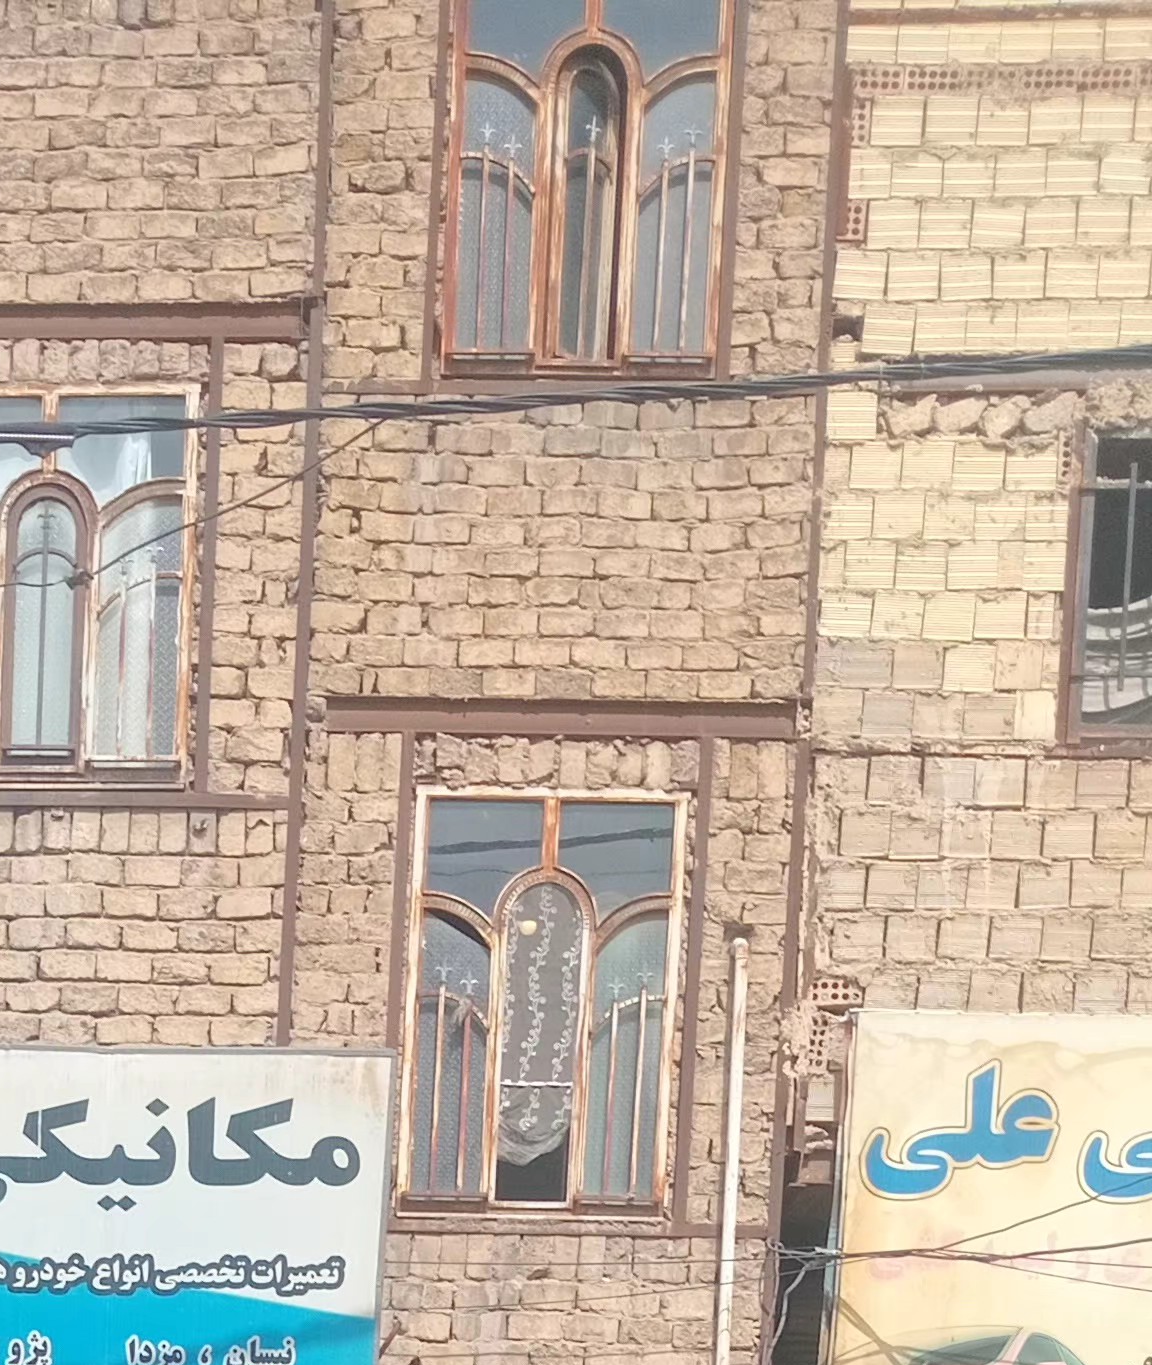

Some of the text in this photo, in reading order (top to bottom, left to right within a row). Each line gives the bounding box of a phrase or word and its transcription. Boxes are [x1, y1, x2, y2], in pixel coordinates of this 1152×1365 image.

[862, 1060, 1058, 1198] علی
[12, 1254, 86, 1290] خودرو
[92, 1256, 151, 1292] انواع
[155, 1258, 246, 1291] تخصصی
[250, 1257, 342, 1293] تعمیرات
